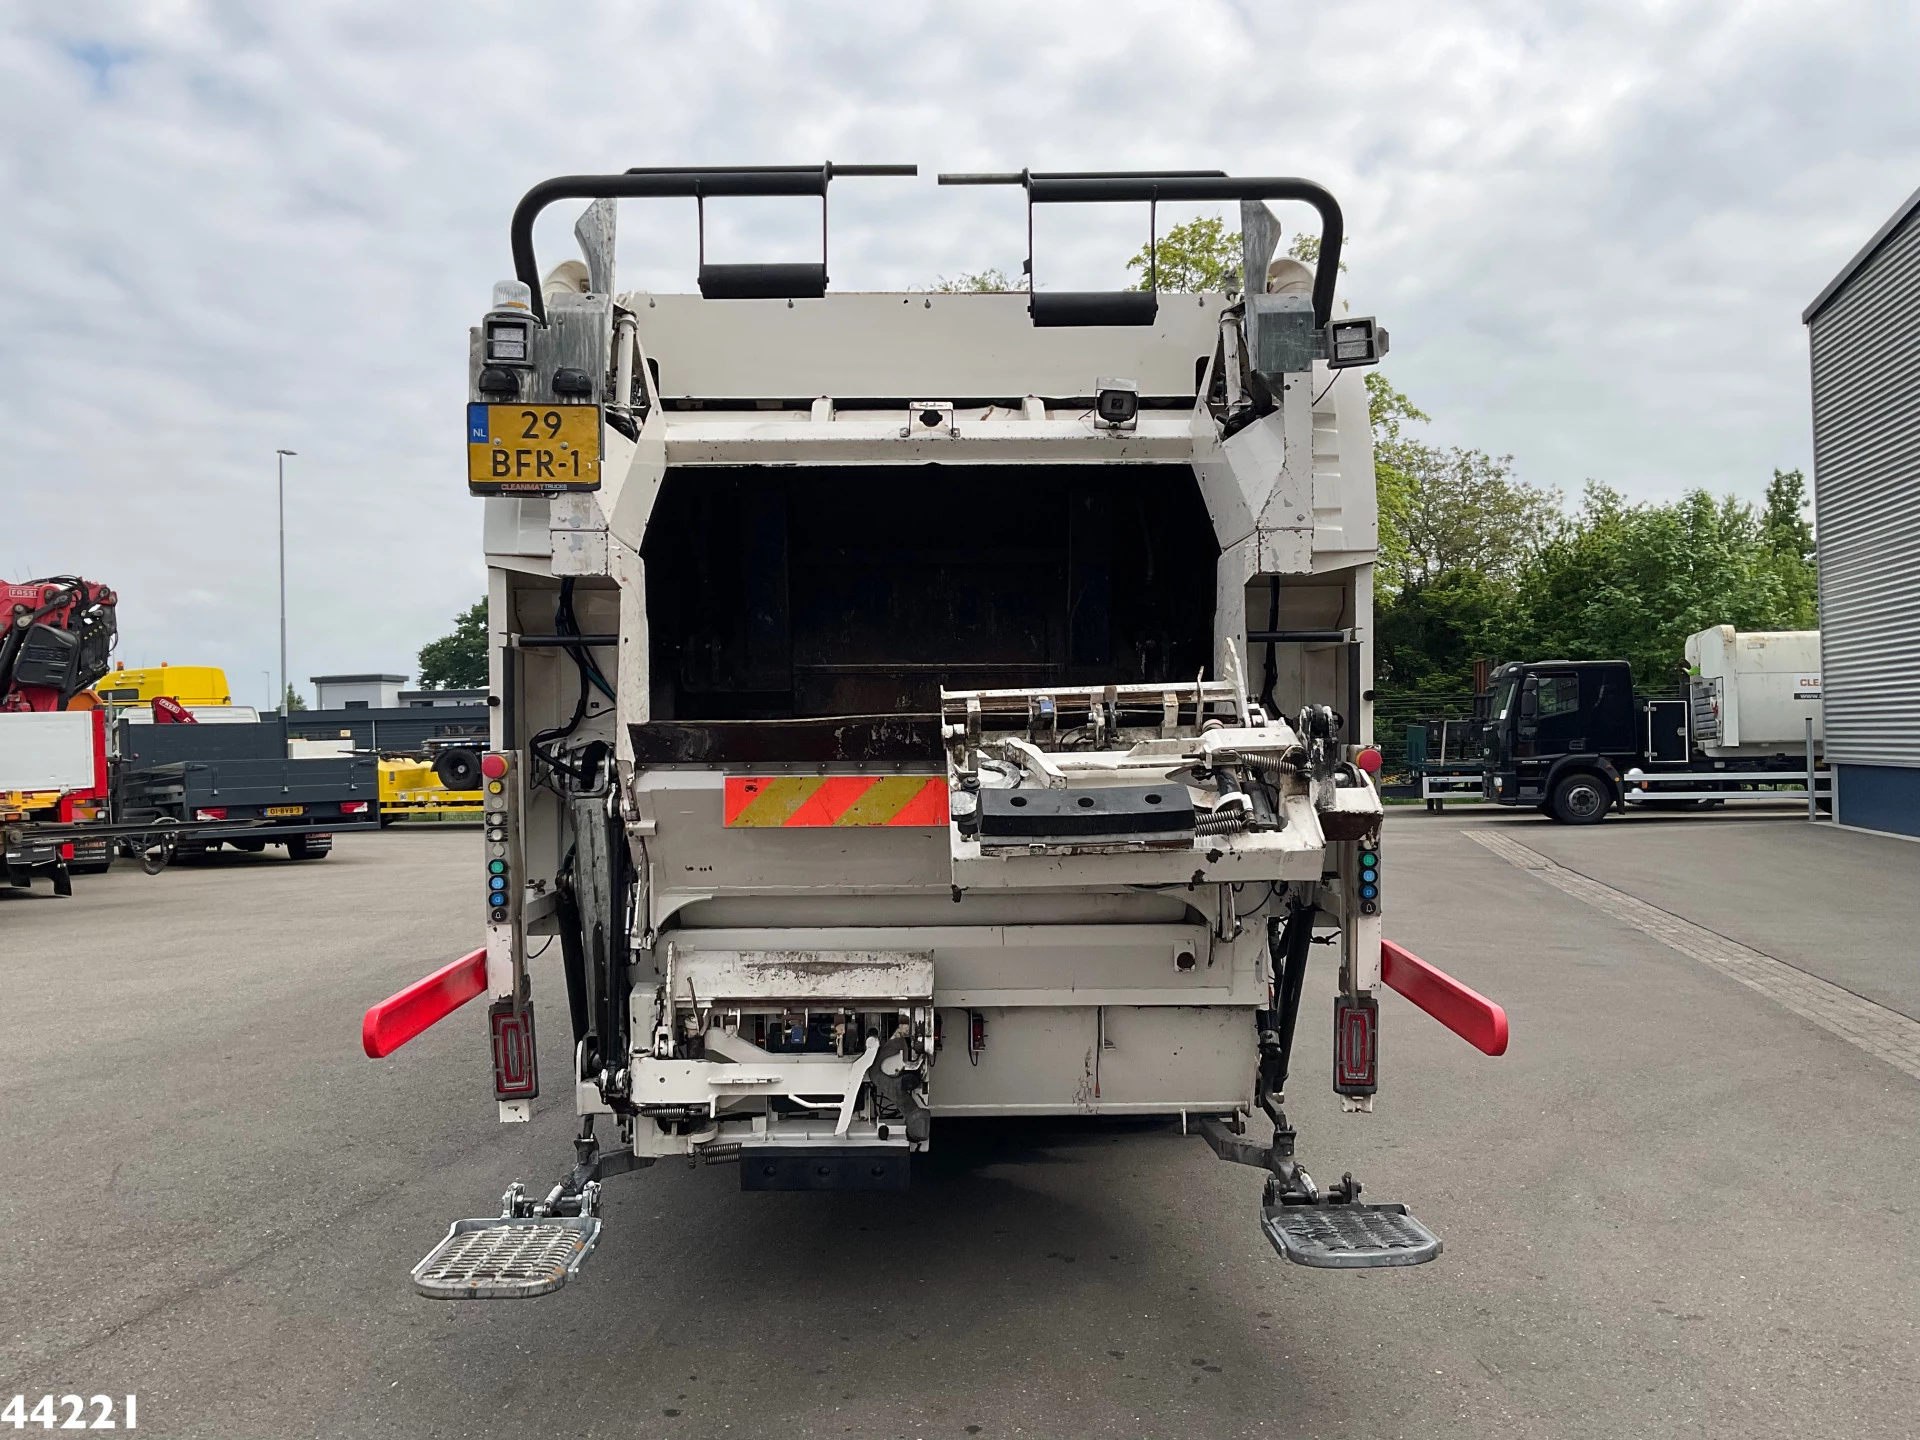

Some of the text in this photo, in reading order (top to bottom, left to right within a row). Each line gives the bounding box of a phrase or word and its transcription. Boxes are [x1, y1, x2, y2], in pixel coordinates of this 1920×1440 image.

[472, 428, 487, 438] NL
[521, 410, 562, 439] 29
[492, 449, 580, 477] BFR-1
[1800, 678, 1822, 686] CLE
